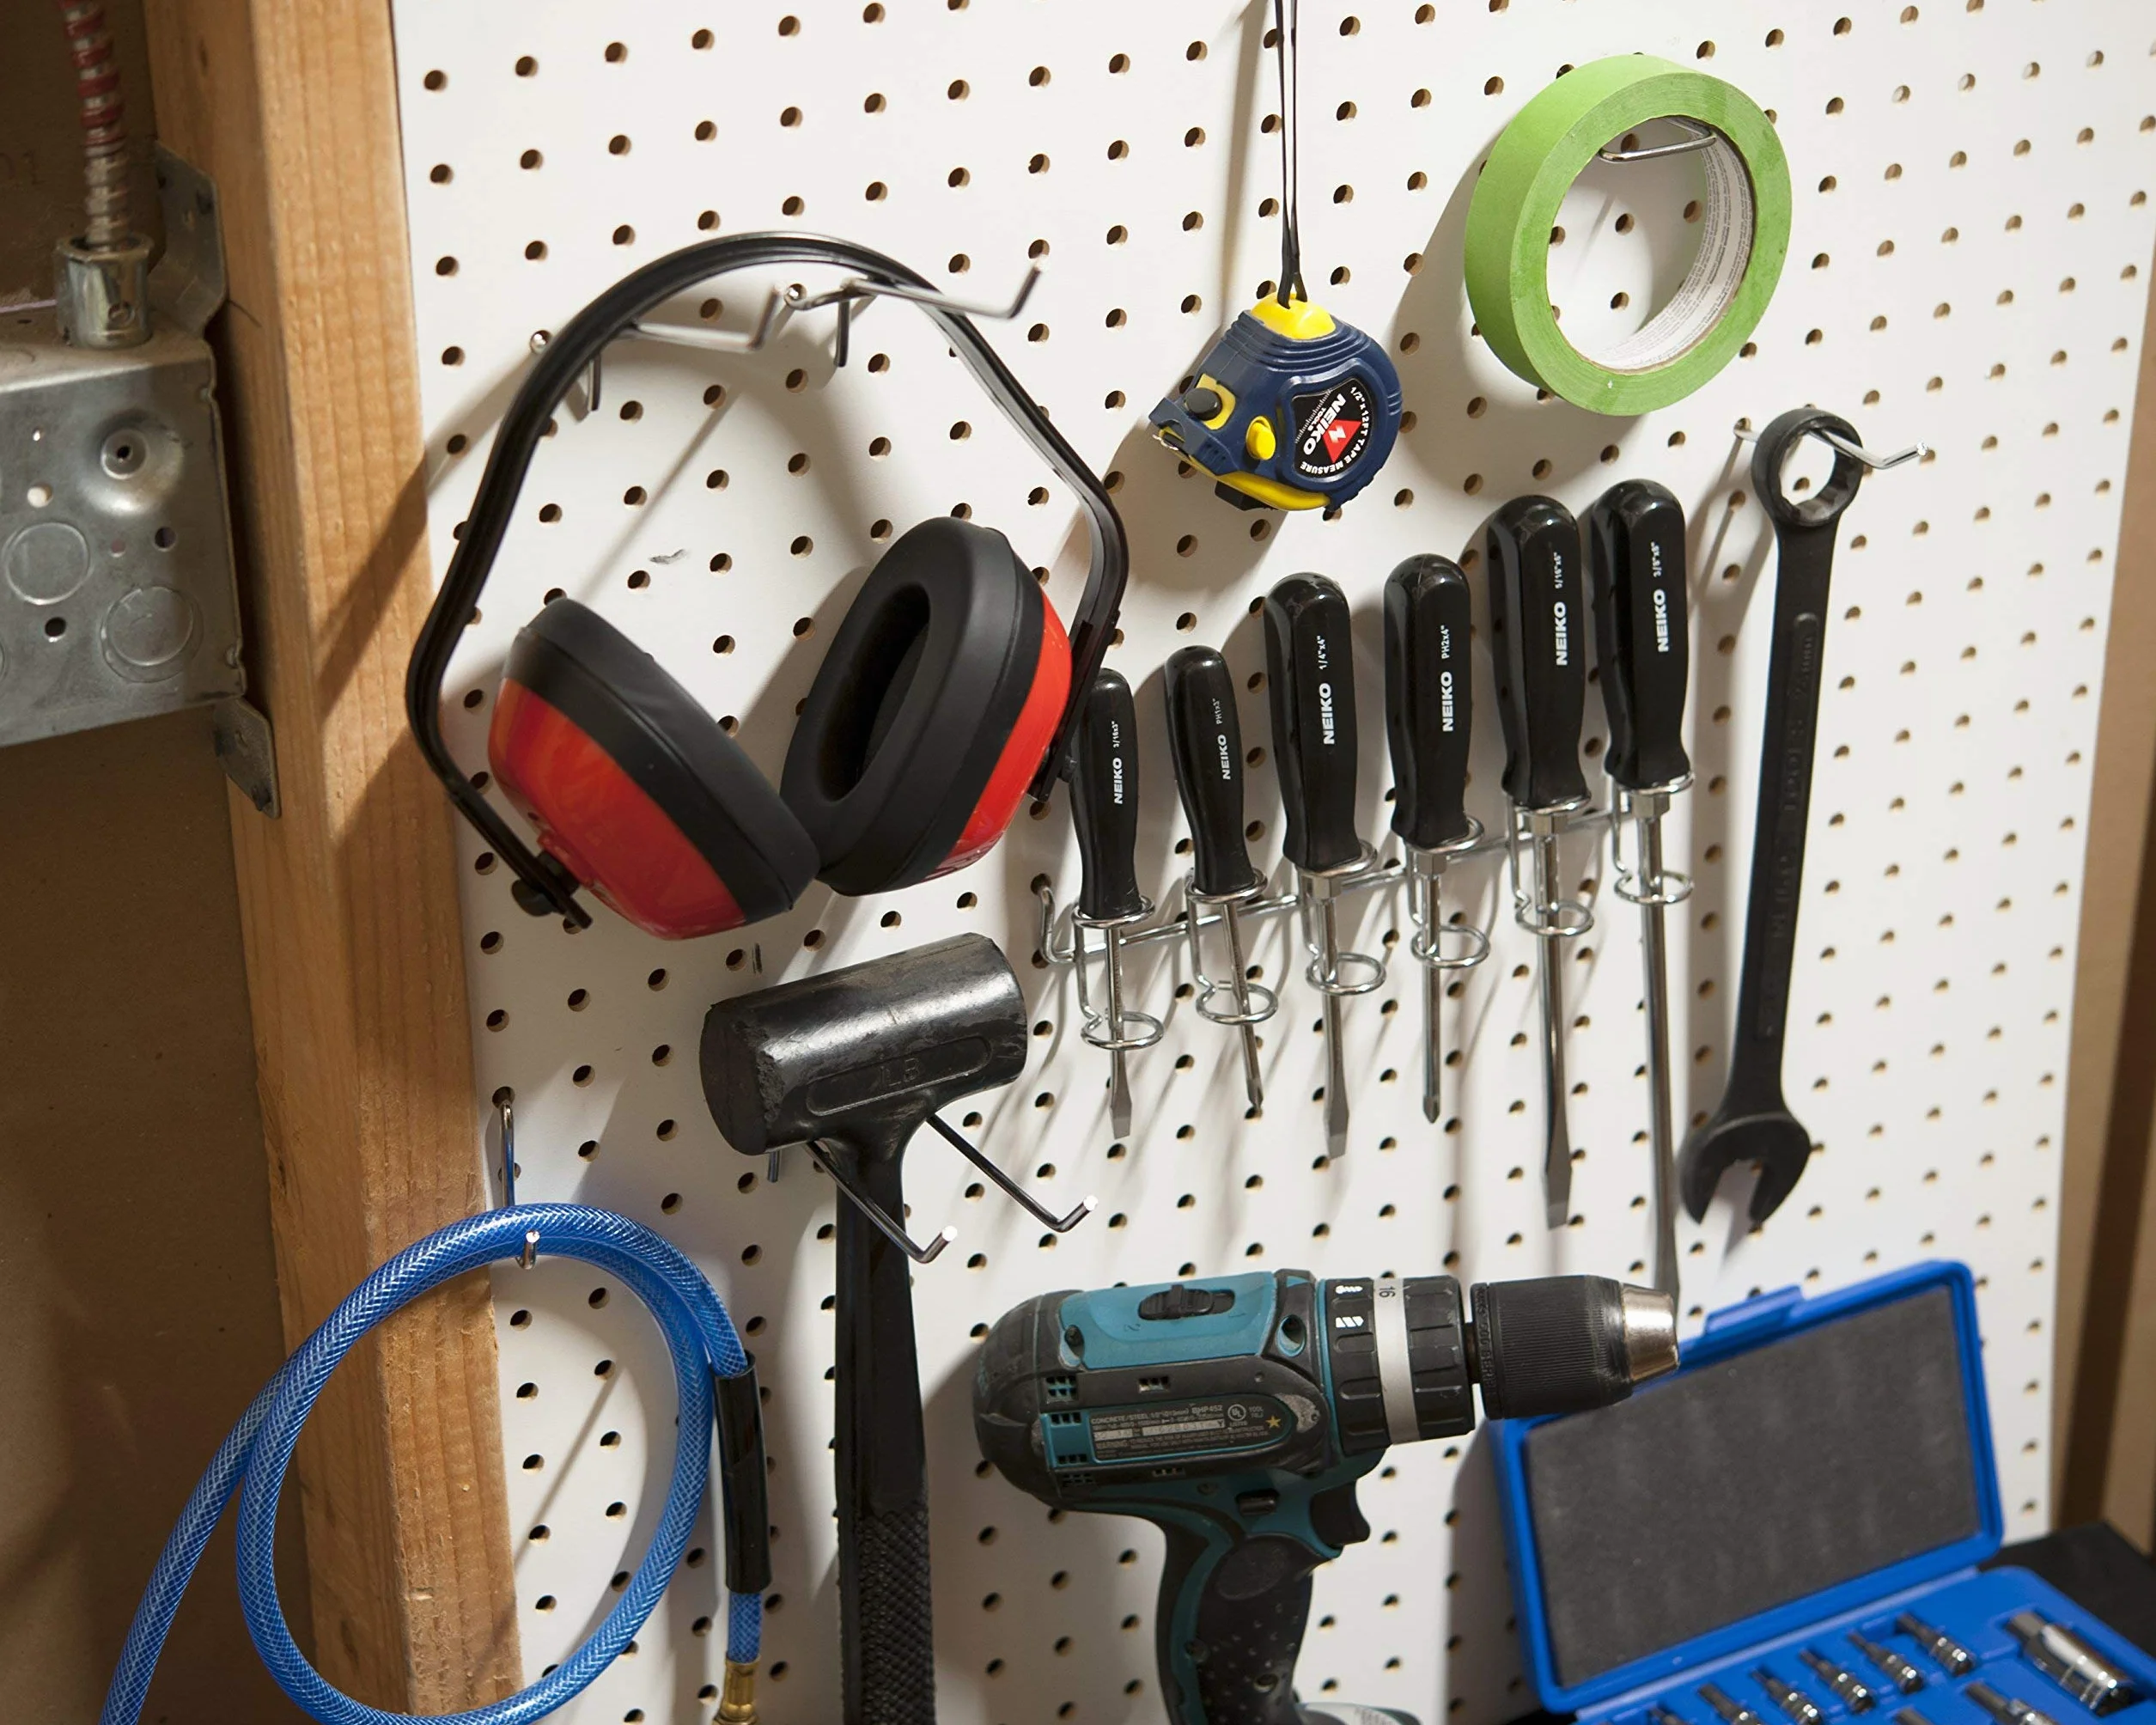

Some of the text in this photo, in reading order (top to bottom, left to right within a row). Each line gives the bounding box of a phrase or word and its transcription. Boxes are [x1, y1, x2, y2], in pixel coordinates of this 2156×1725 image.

[1350, 387, 1365, 402] 1/2"
[1303, 393, 1346, 455] NEIKO
[1307, 407, 1327, 431] TOOLS
[1361, 410, 1369, 436] 12FT
[1300, 460, 1344, 474] MEASURE
[1344, 439, 1365, 464] TAPE
[1554, 601, 1568, 666] NEIKO
[1654, 589, 1669, 652] NEIKO
[1316, 636, 1335, 745] NEIKO 1/4"x4"
[1440, 625, 1453, 732] NEIKO PH2x4"
[1217, 734, 1231, 780] NEIKO
[1112, 758, 1124, 804] NEIKO
[1379, 1285, 1396, 1298] 16
